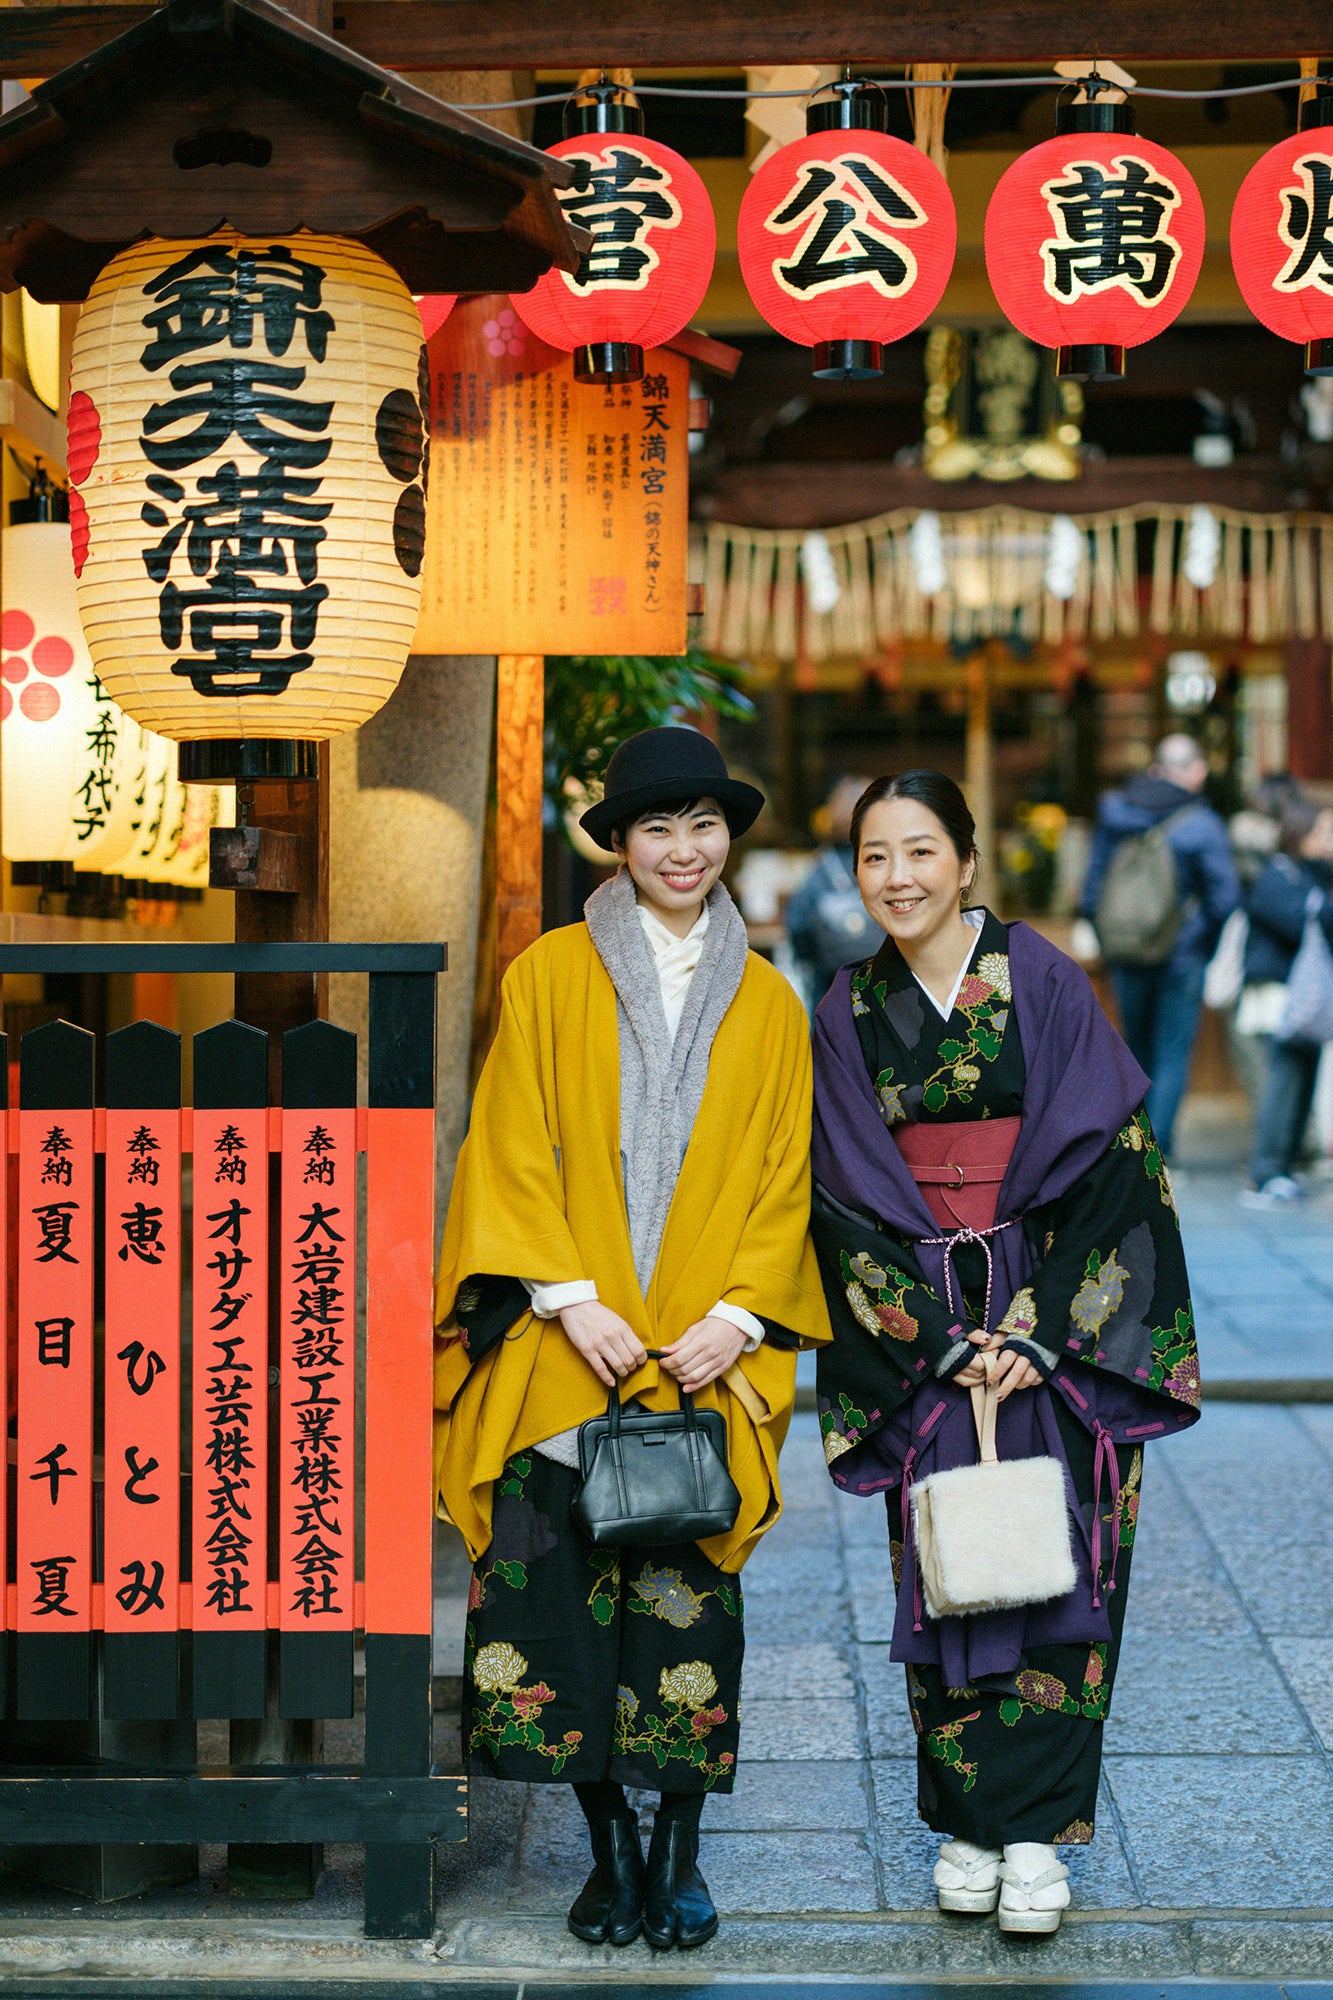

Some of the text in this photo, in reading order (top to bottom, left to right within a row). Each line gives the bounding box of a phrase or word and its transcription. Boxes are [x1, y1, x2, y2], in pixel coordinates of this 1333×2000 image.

[773, 160, 917, 292] 公
[1050, 159, 1176, 299] 萬
[140, 245, 336, 697] 錦天満宮
[30, 1126, 79, 1616] 奉納 夏目千夏
[127, 1126, 160, 1186] 奉納
[204, 1125, 256, 1615] 奉納 オサダ工芸株式会社
[290, 1126, 345, 1617] 奉納 大岩建設工業株式会社
